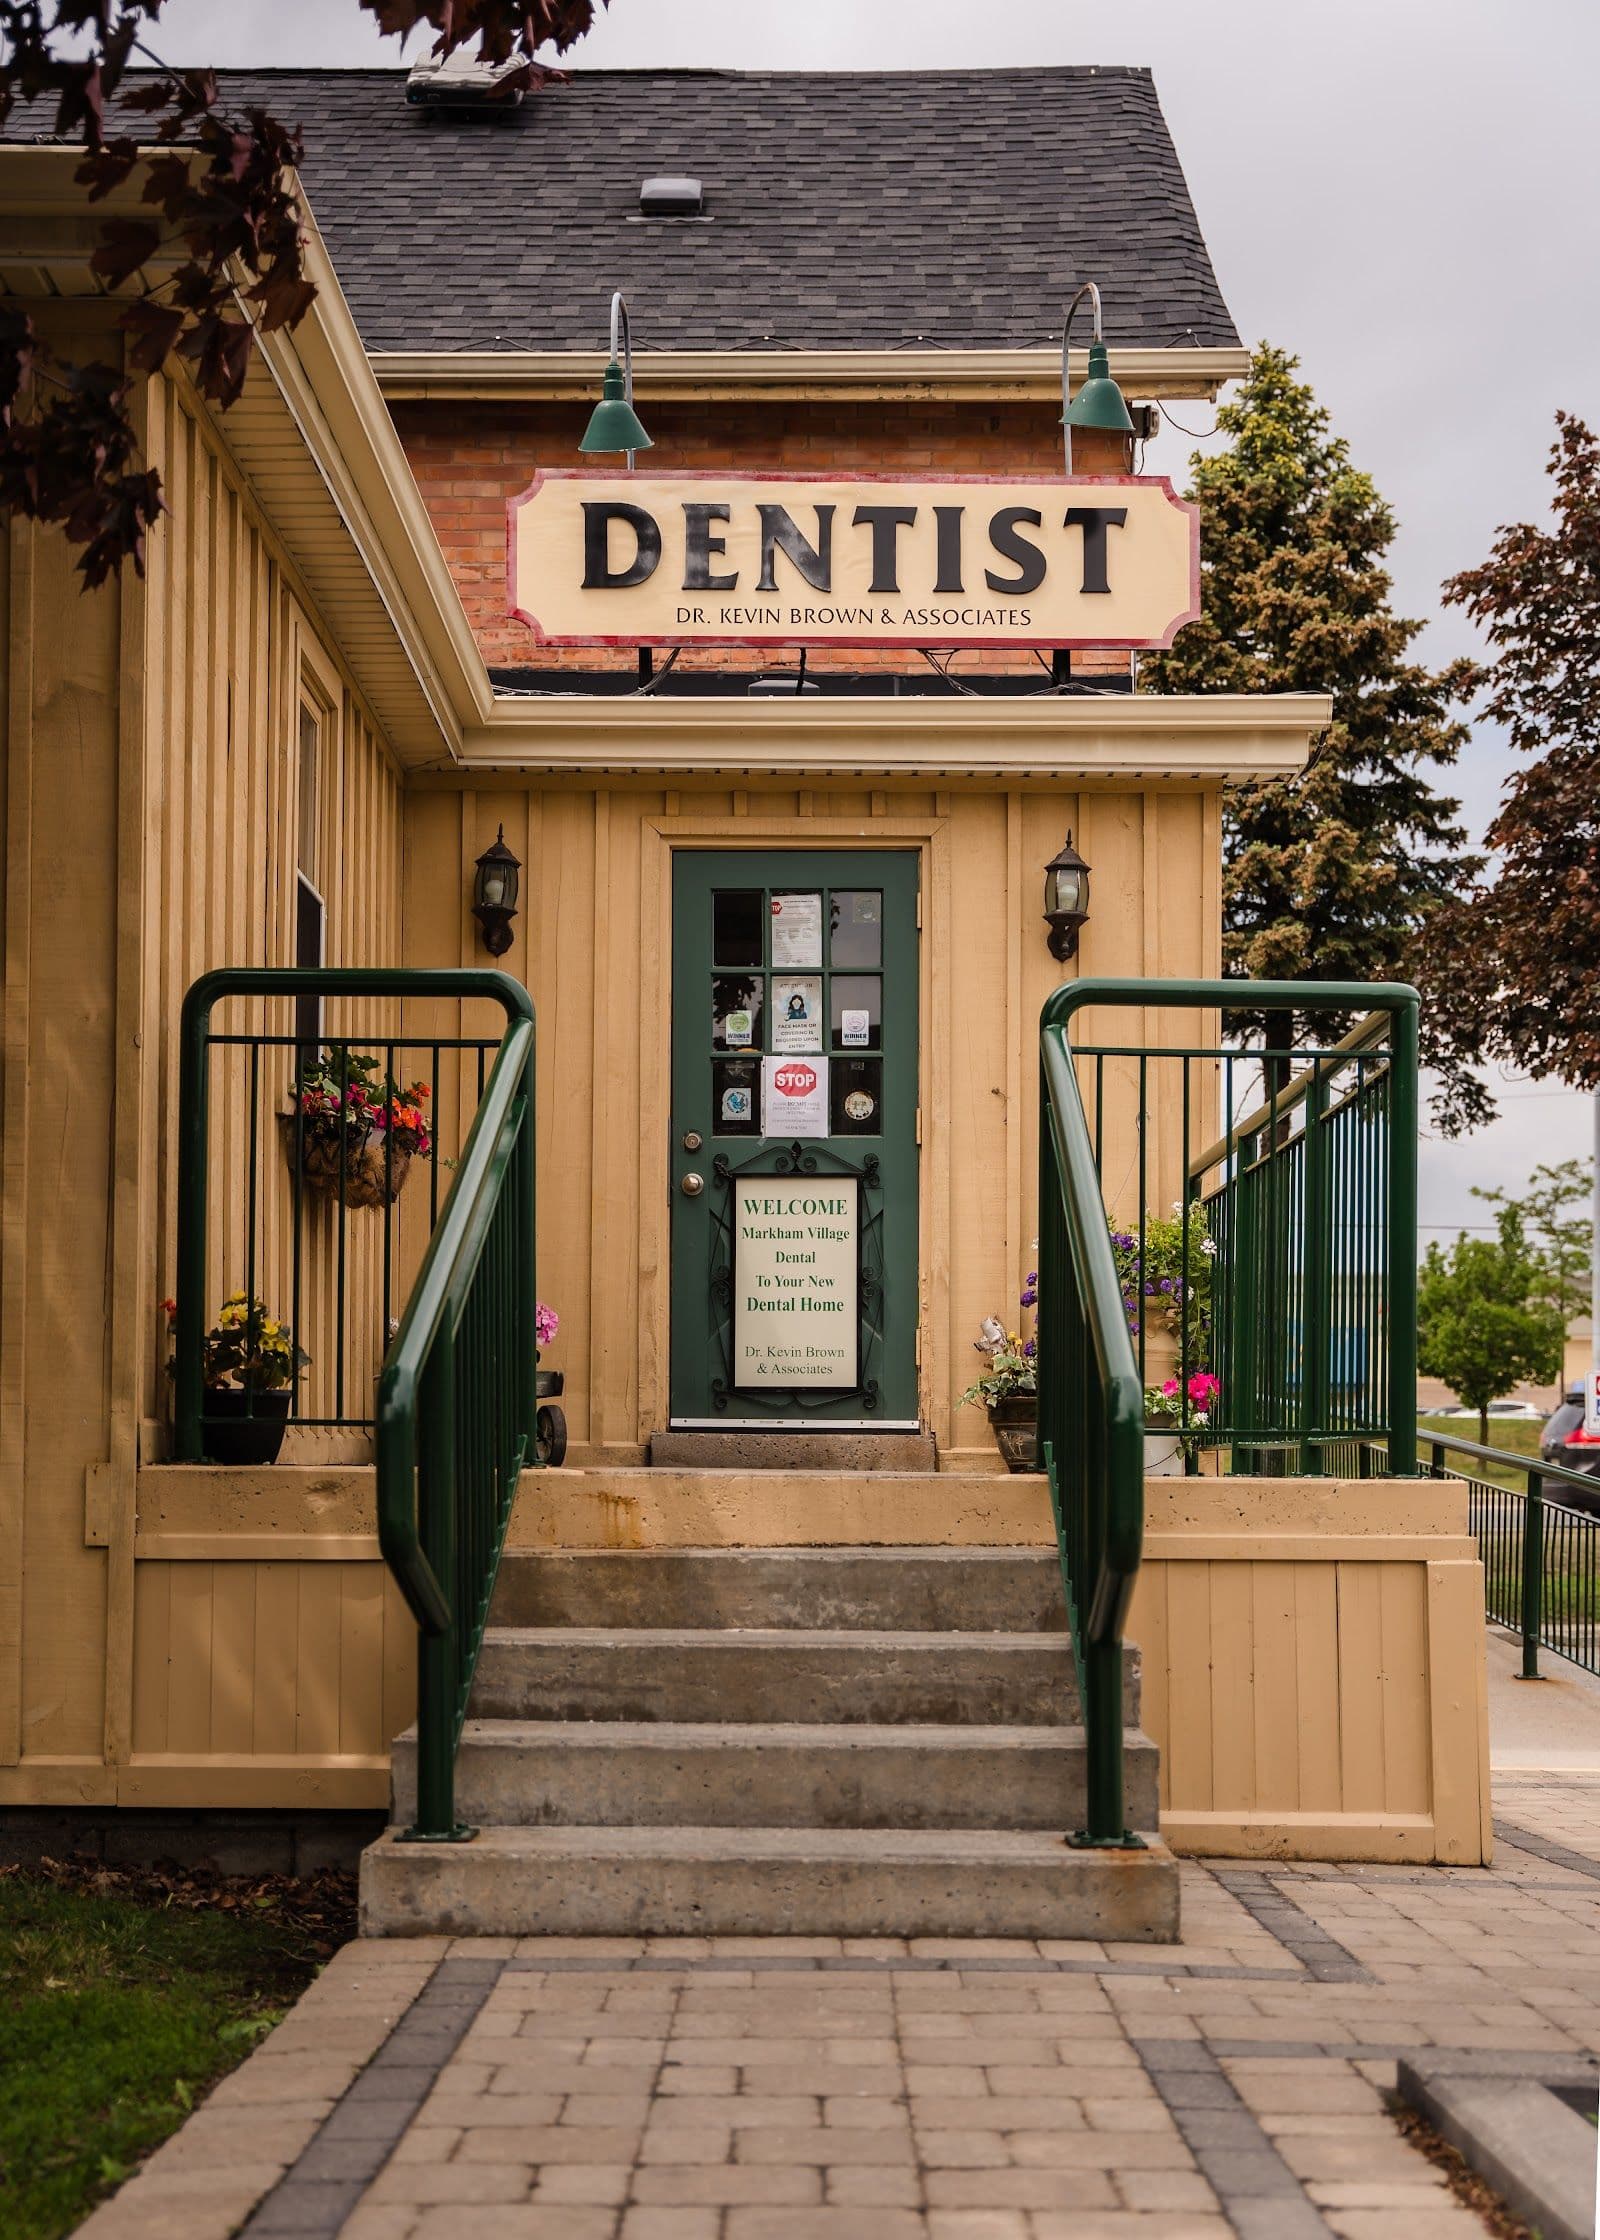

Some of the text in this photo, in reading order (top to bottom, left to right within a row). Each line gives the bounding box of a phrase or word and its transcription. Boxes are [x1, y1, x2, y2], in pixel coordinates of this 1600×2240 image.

[580, 501, 1129, 596] DENTIST
[676, 607, 1032, 627] DR. KEVIN BROWN & ASSOCIATES
[776, 1073, 815, 1087] STOP
[743, 1198, 848, 1216] WELCOME
[741, 1226, 850, 1242] Markham Village
[775, 1251, 816, 1264] Dental
[755, 1275, 836, 1288] To Your New
[746, 1296, 844, 1312] Dental Home
[745, 1346, 845, 1358] Dr. Kevin Brown
[756, 1362, 833, 1375] & Associates
